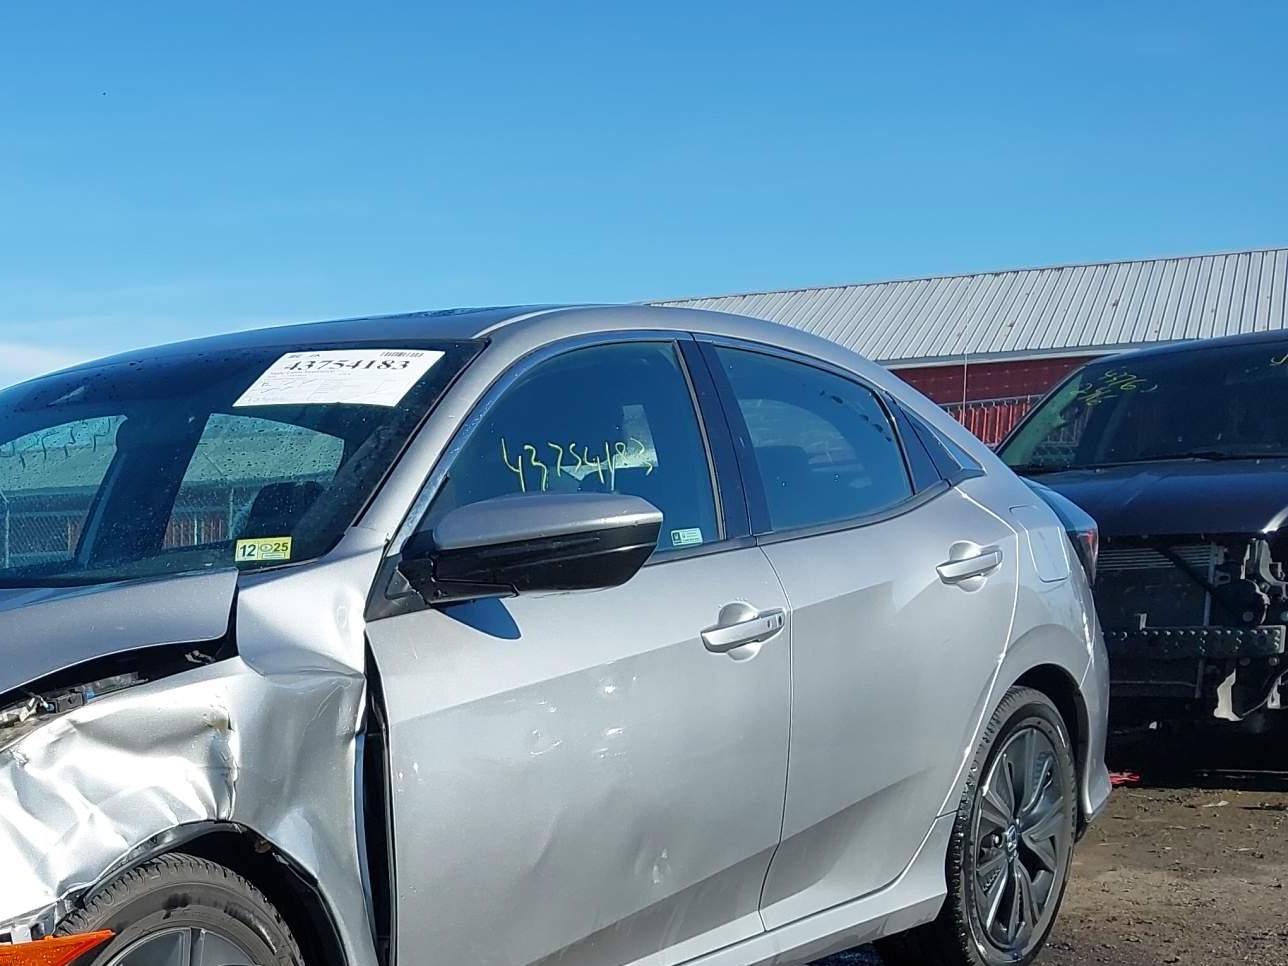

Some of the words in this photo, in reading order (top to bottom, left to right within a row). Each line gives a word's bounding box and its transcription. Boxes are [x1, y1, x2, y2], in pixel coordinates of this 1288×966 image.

[284, 360, 410, 371] 43754183
[240, 544, 257, 557] 12
[274, 542, 289, 552] 25
